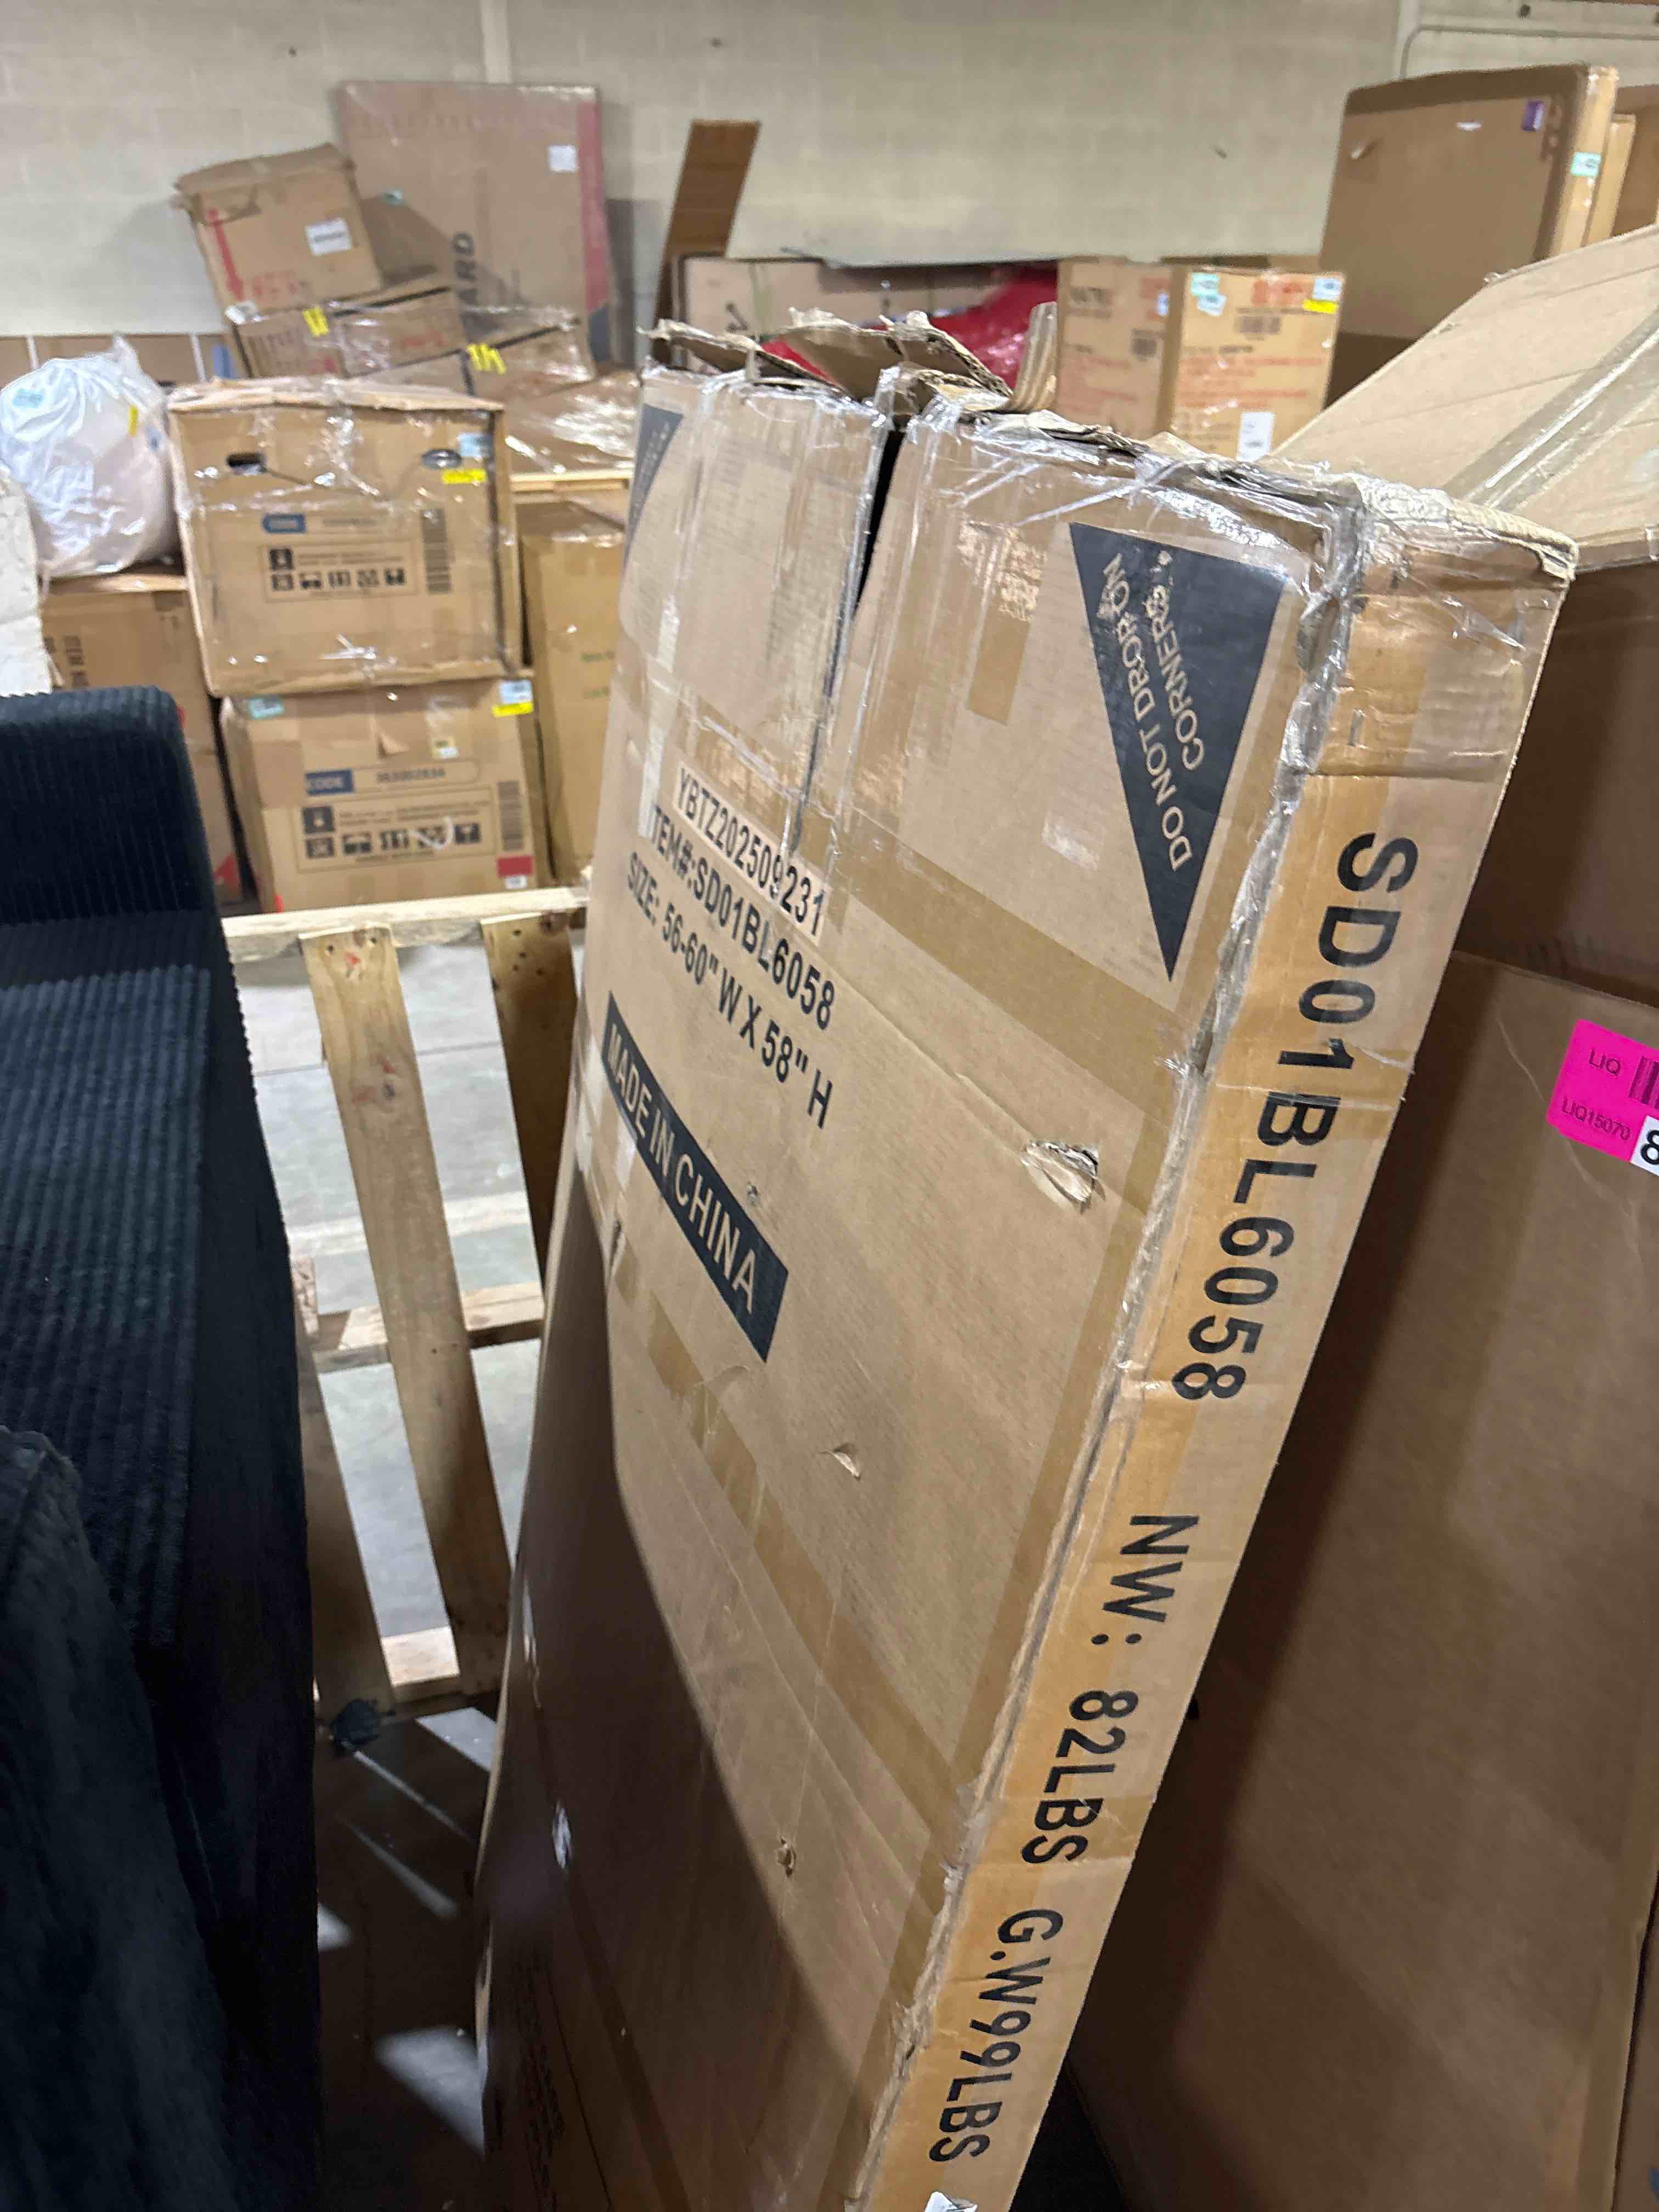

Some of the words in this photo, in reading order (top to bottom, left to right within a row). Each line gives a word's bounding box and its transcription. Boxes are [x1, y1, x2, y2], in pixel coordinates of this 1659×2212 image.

[678, 767, 825, 936] YBTZ202509231
[1138, 728, 1177, 806] NOT
[1161, 806, 1193, 872] DO
[628, 850, 660, 926] SIZE:
[718, 967, 742, 1024] W
[740, 995, 763, 1049] X
[761, 1019, 808, 1084] 58"
[807, 1068, 833, 1130] H
[650, 802, 834, 1030] TEM#:SD01BL6058
[1171, 832, 1419, 1401] SD01BL6058
[1561, 1097, 1631, 1141] LIQ15070
[1588, 1047, 1622, 1077] LIQ
[608, 1024, 651, 1138] MADE
[649, 1109, 675, 1176] IN
[675, 1153, 756, 1315] CHINA
[1091, 1515, 1200, 1646] NW:
[1021, 1690, 1139, 1864] 82LBS
[929, 1908, 1064, 2163] G.W99LBS
